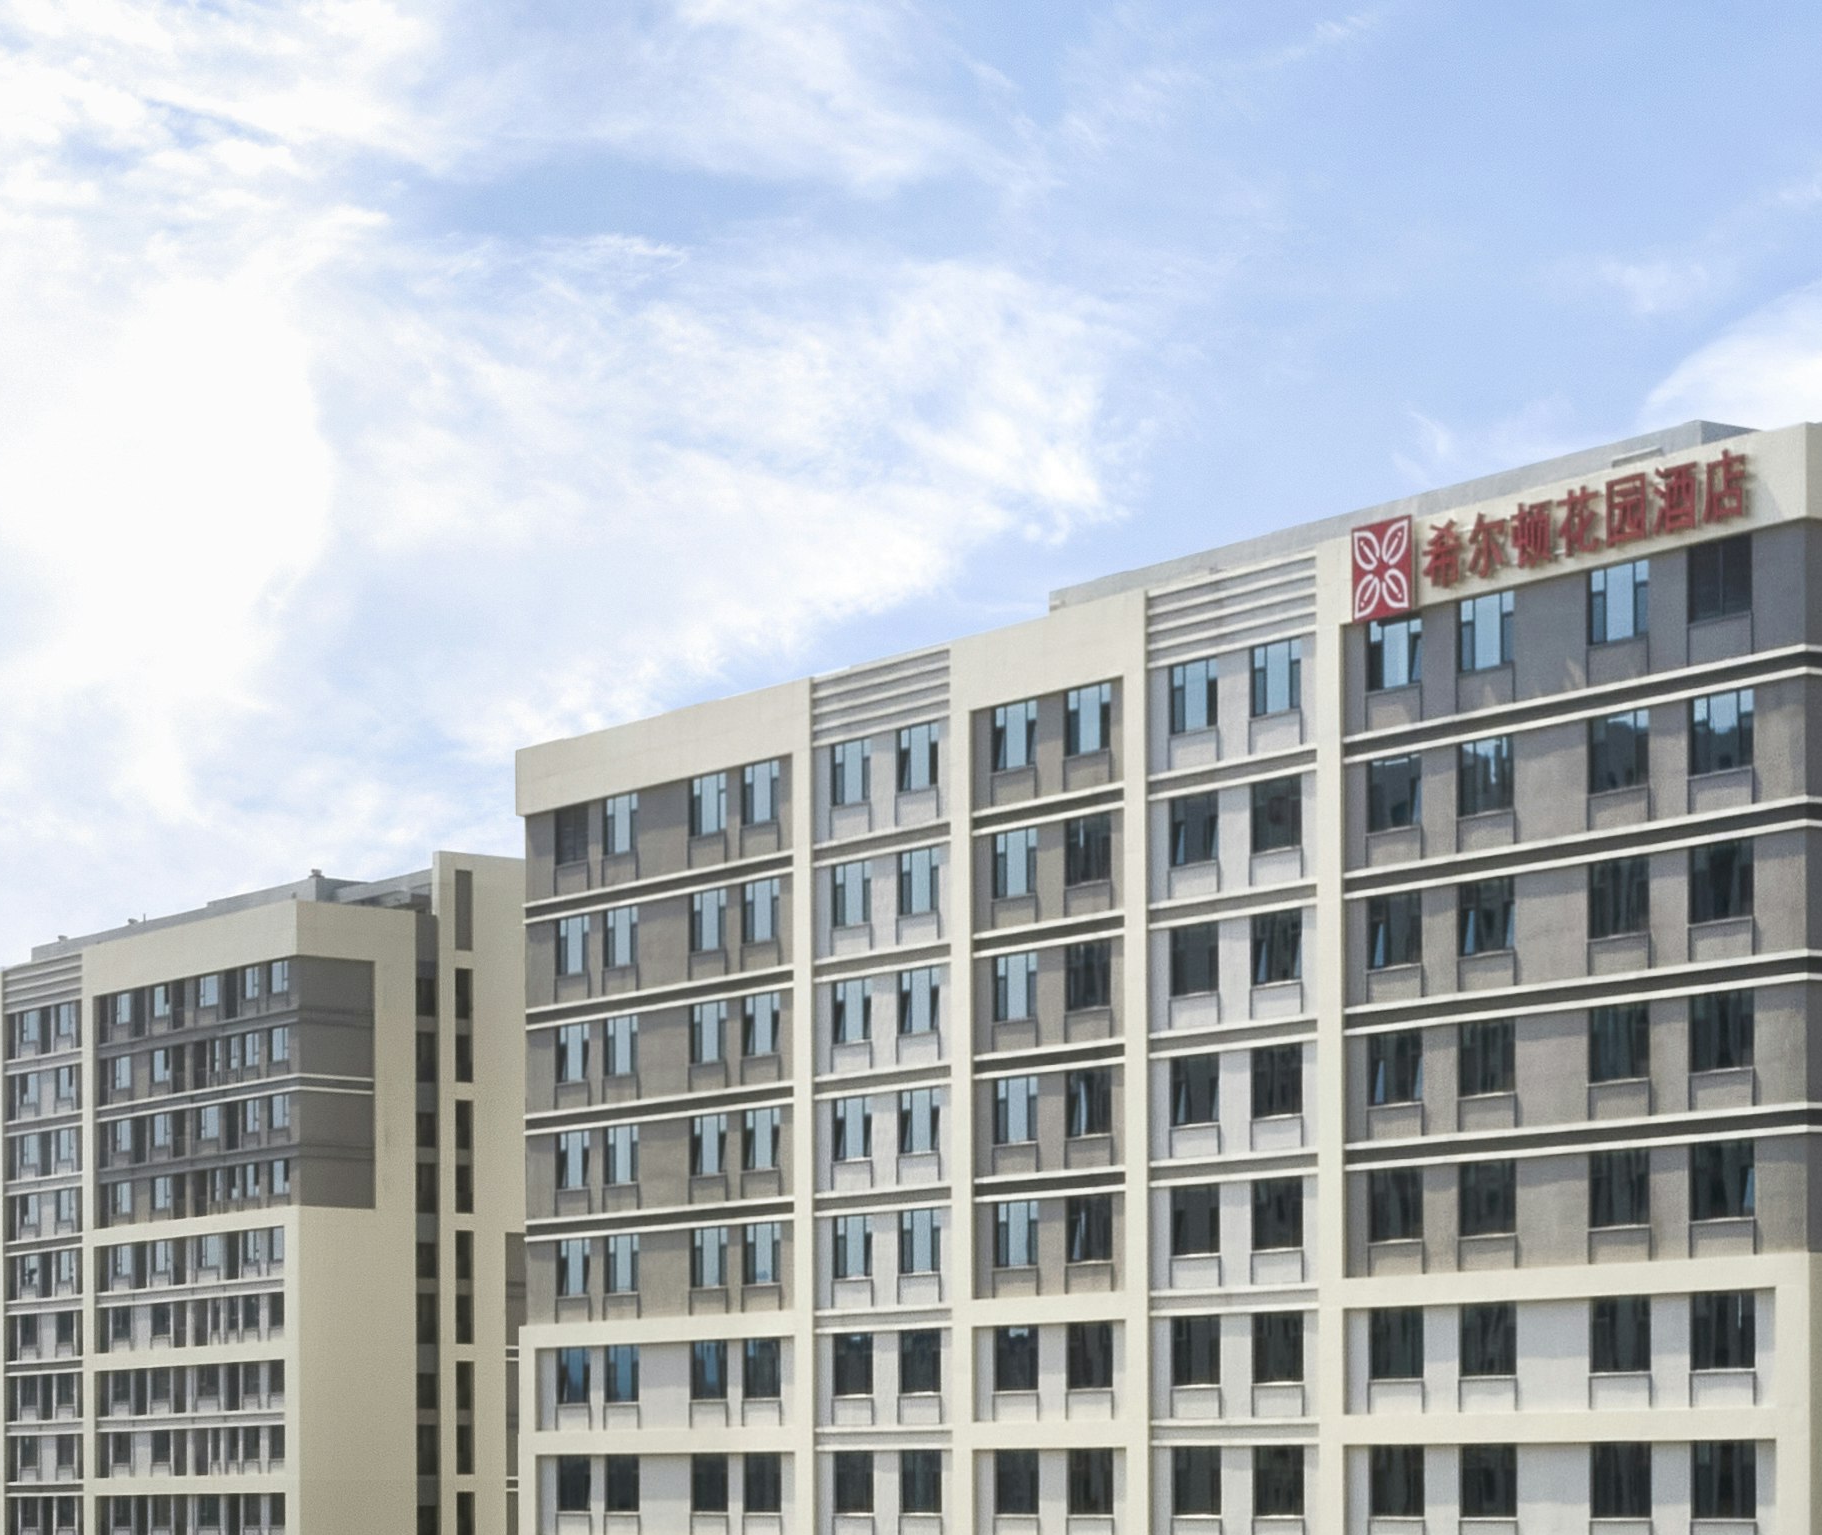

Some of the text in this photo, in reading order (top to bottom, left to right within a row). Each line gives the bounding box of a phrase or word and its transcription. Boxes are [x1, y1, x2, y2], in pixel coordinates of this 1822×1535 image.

[1422, 449, 1752, 588] 希尔顿花园酒店
